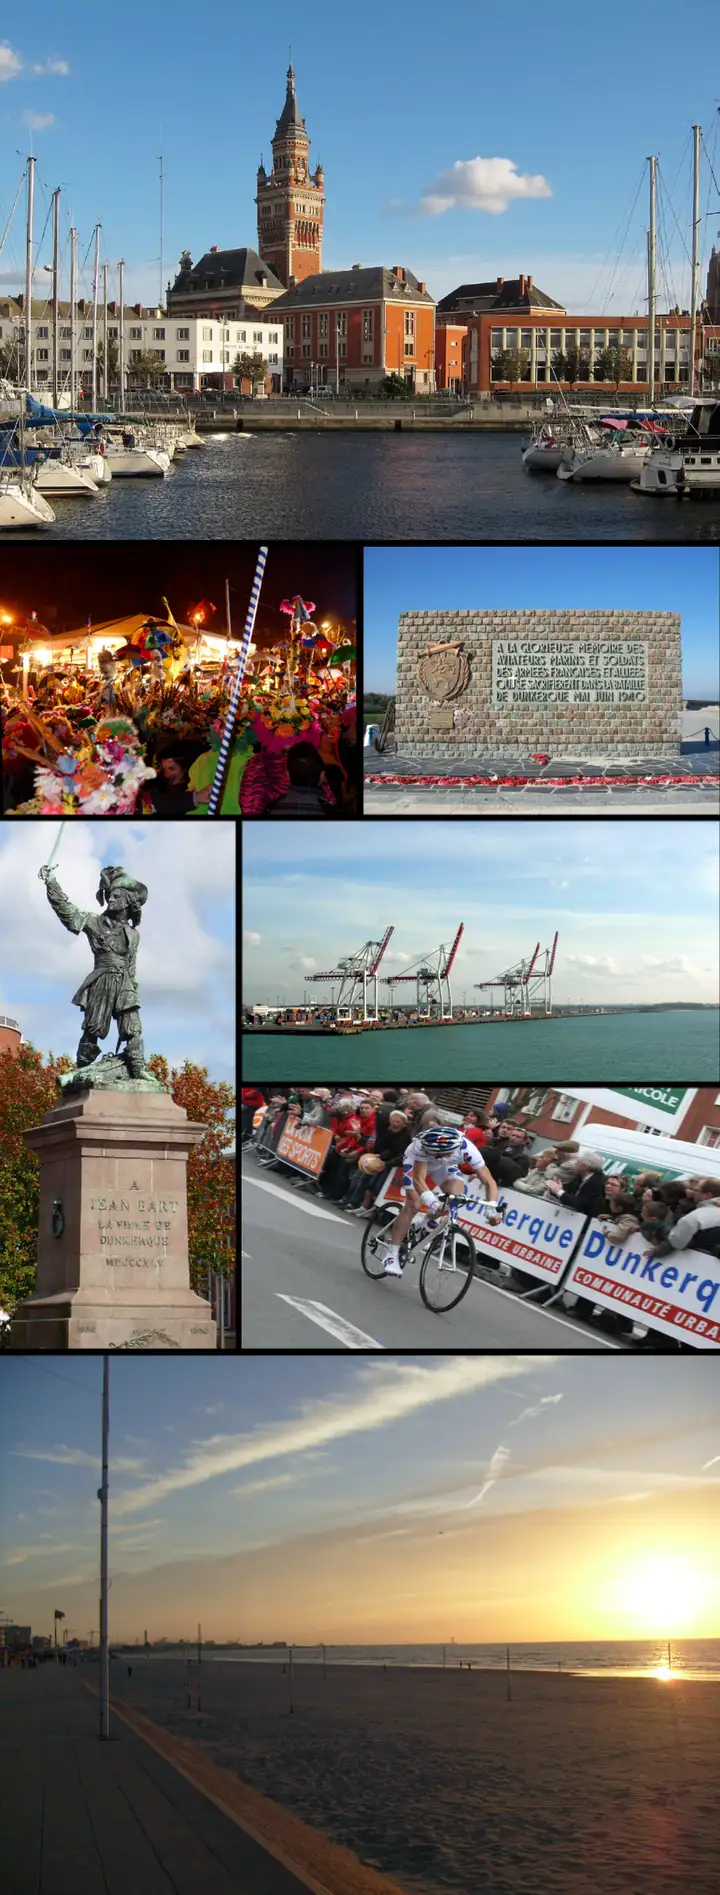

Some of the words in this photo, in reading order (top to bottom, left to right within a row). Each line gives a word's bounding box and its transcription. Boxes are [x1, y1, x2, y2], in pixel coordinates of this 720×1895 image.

[497, 643, 504, 653] A
[507, 643, 518, 653] LA
[520, 643, 574, 654] GLORIEUSE
[627, 643, 645, 654] DES
[497, 655, 546, 666] AVIATEURS
[550, 655, 585, 666] MARINS
[588, 655, 600, 666] ET
[603, 655, 645, 666] SOLDATS
[497, 667, 513, 678] DES
[603, 667, 613, 678] ET
[581, 679, 603, 690] DANS
[603, 679, 613, 690] LA
[614, 679, 645, 690] BATAILLE
[496, 691, 508, 702] DE
[512, 691, 569, 702] DUNKERQUE
[574, 691, 591, 702] MAI
[595, 691, 614, 702] JUIN
[618, 691, 646, 702] 1940
[129, 1180, 140, 1190] A
[91, 1199, 130, 1212] JEAN
[138, 1200, 179, 1213] BART
[98, 1220, 113, 1230] LA
[115, 1220, 150, 1231] VILLE
[155, 1221, 171, 1231] DE
[100, 1235, 169, 1247] DUNKERQUE
[512, 1247, 562, 1272] URBAINE
[576, 1271, 671, 1317] COMMUNAUTÉ
